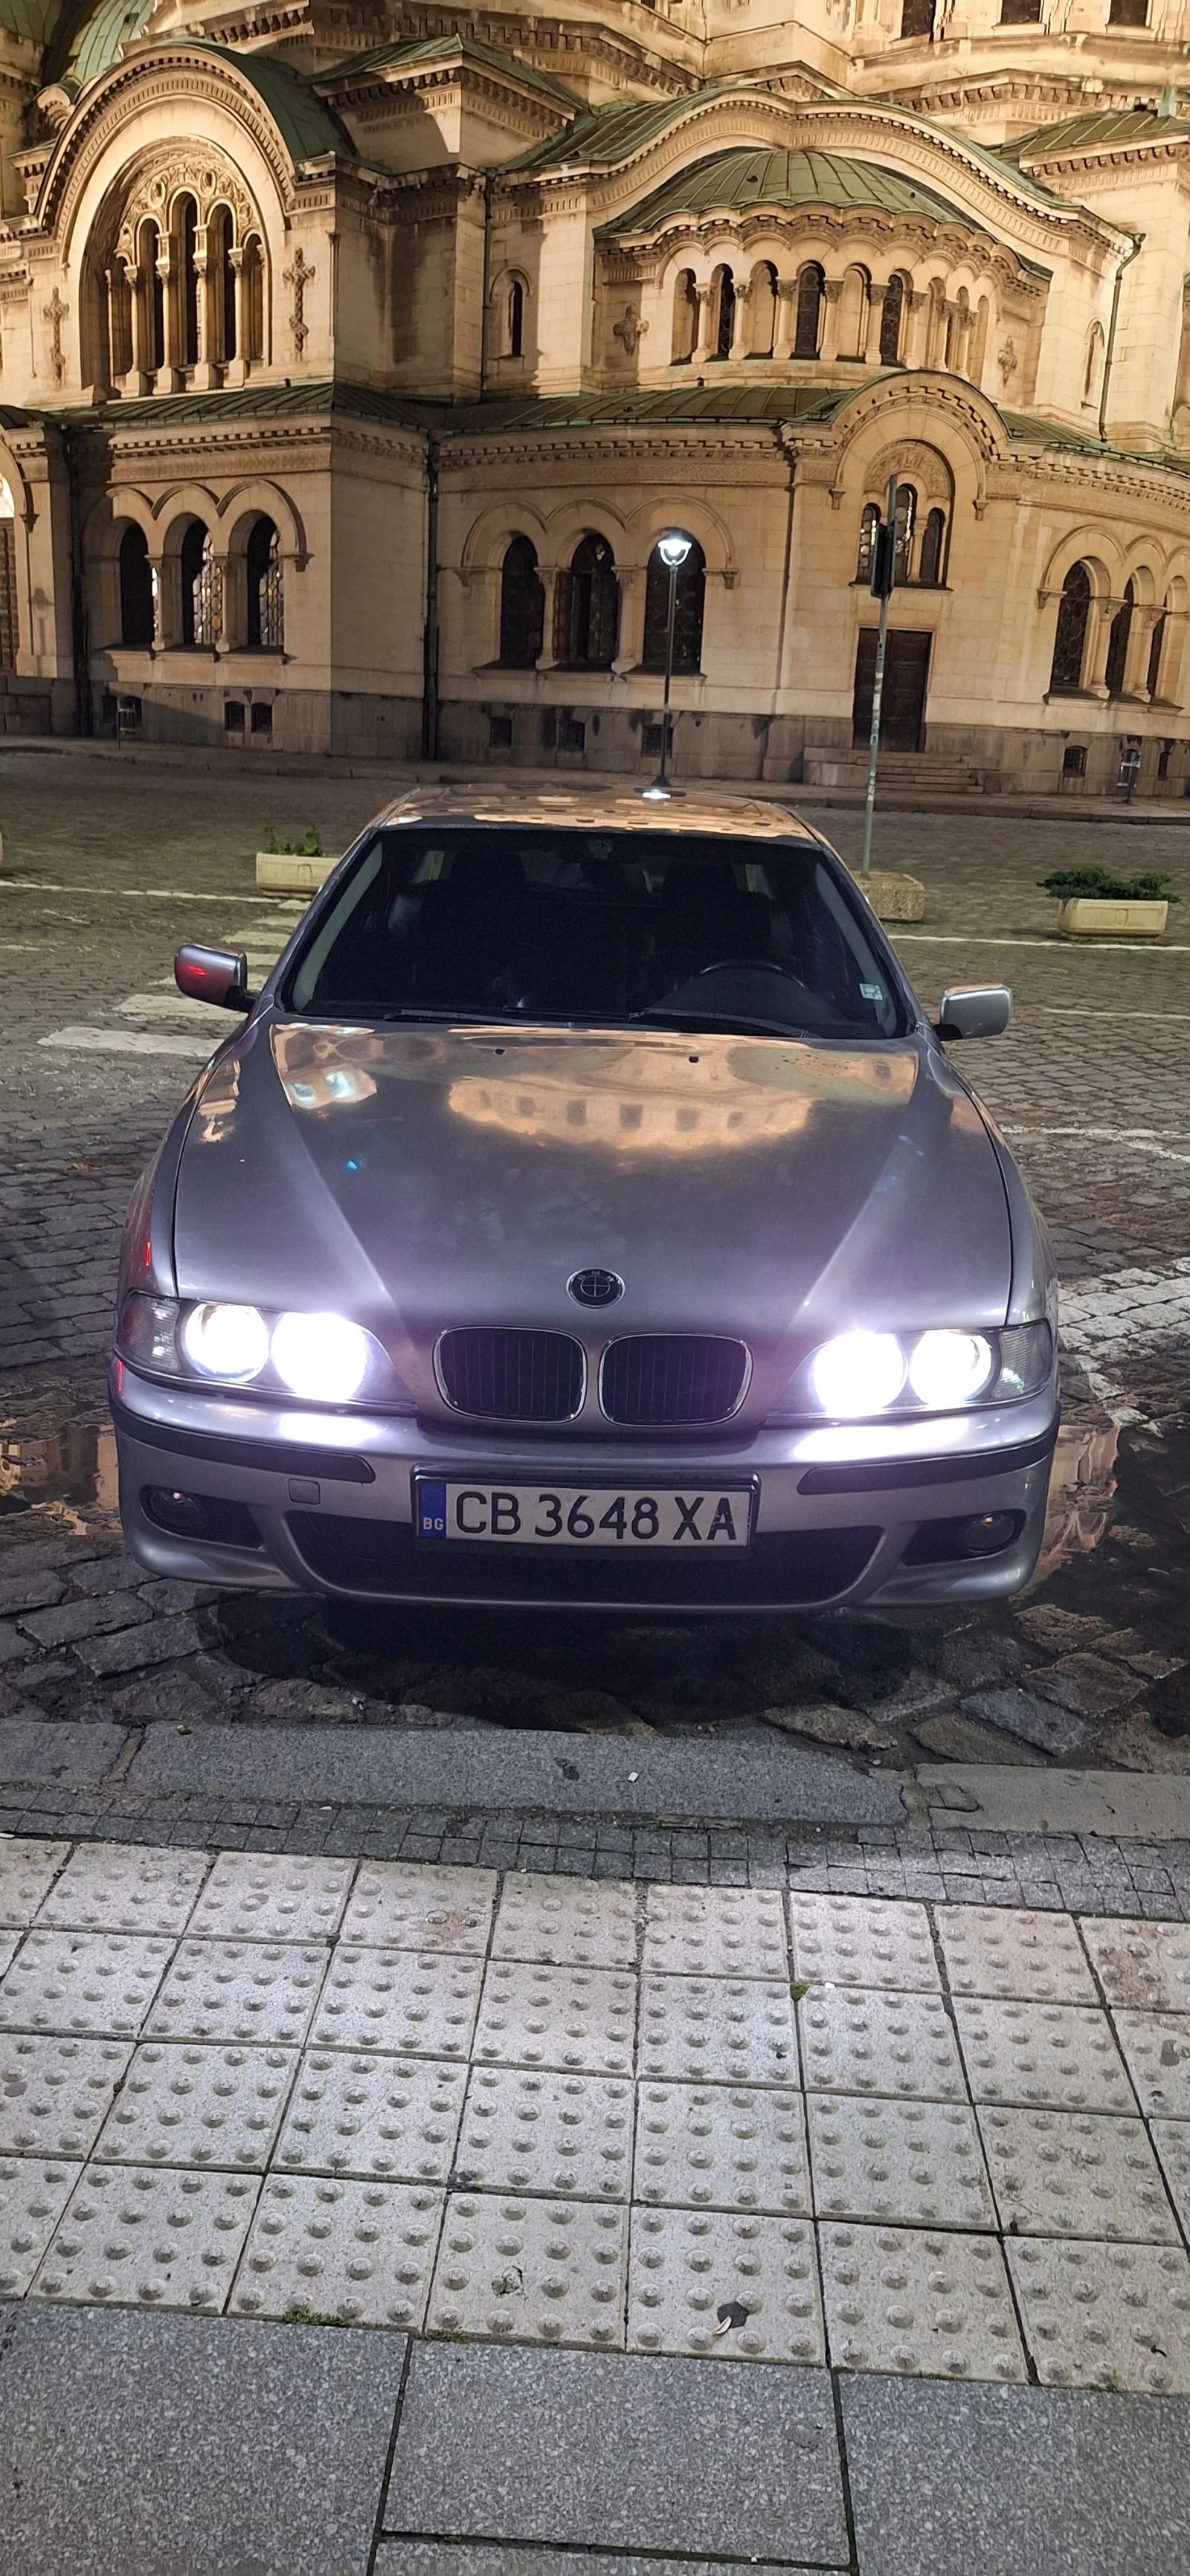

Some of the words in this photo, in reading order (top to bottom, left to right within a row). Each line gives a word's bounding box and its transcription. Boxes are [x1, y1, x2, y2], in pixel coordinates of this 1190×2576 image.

[423, 1517, 444, 1531] BG
[455, 1491, 521, 1535] CB
[534, 1493, 660, 1539] 3648
[672, 1496, 737, 1541] XA
